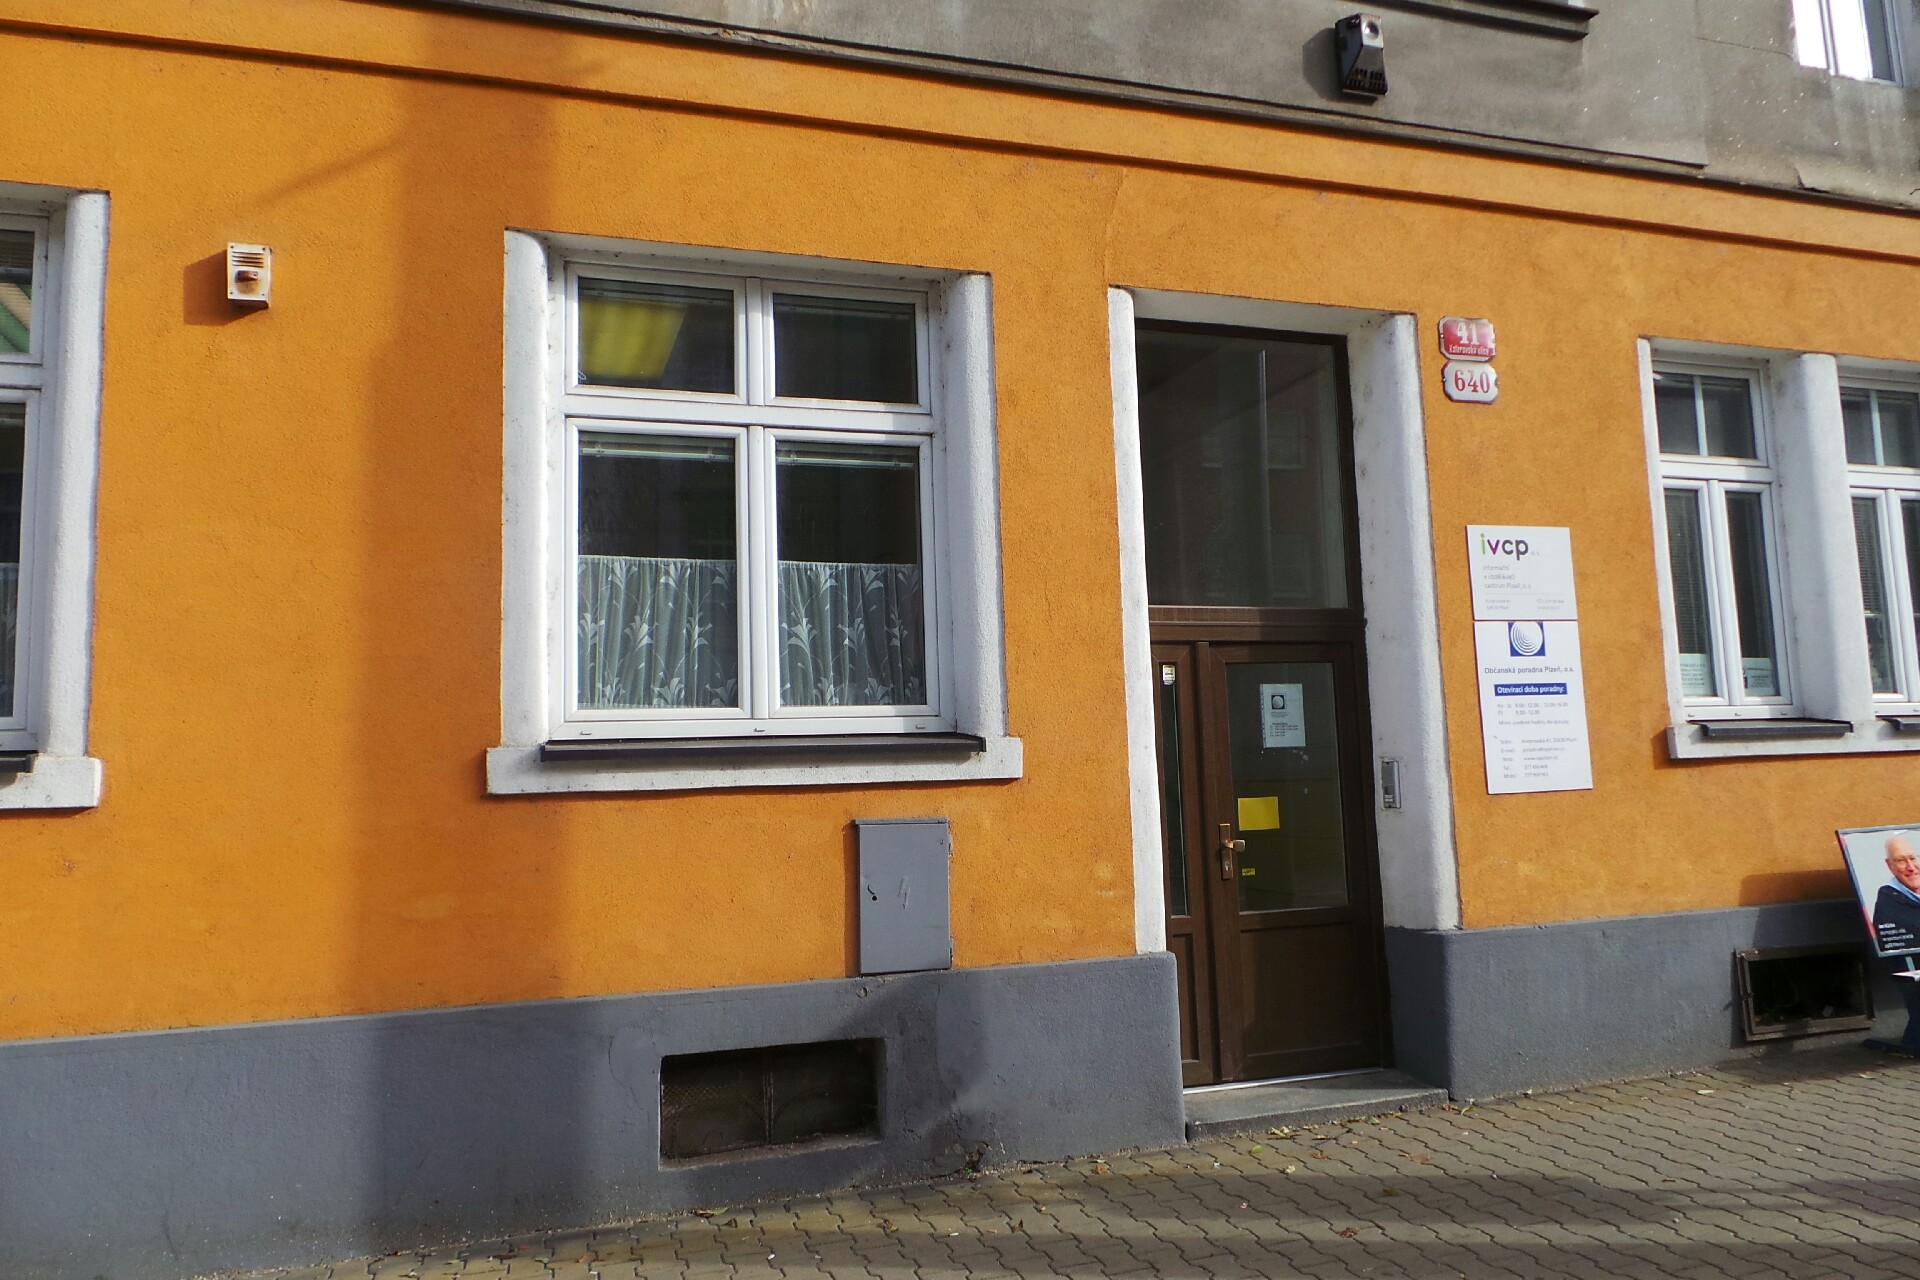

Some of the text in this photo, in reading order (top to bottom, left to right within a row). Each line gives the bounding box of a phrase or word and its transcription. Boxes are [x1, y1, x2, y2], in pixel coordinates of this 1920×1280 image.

[1457, 322, 1480, 345] 41
[1454, 369, 1490, 394] 640
[1480, 533, 1529, 561] ivcp
[1484, 666, 1516, 674] Občanská
[1517, 667, 1543, 677] poradna
[1524, 685, 1539, 693] doba
